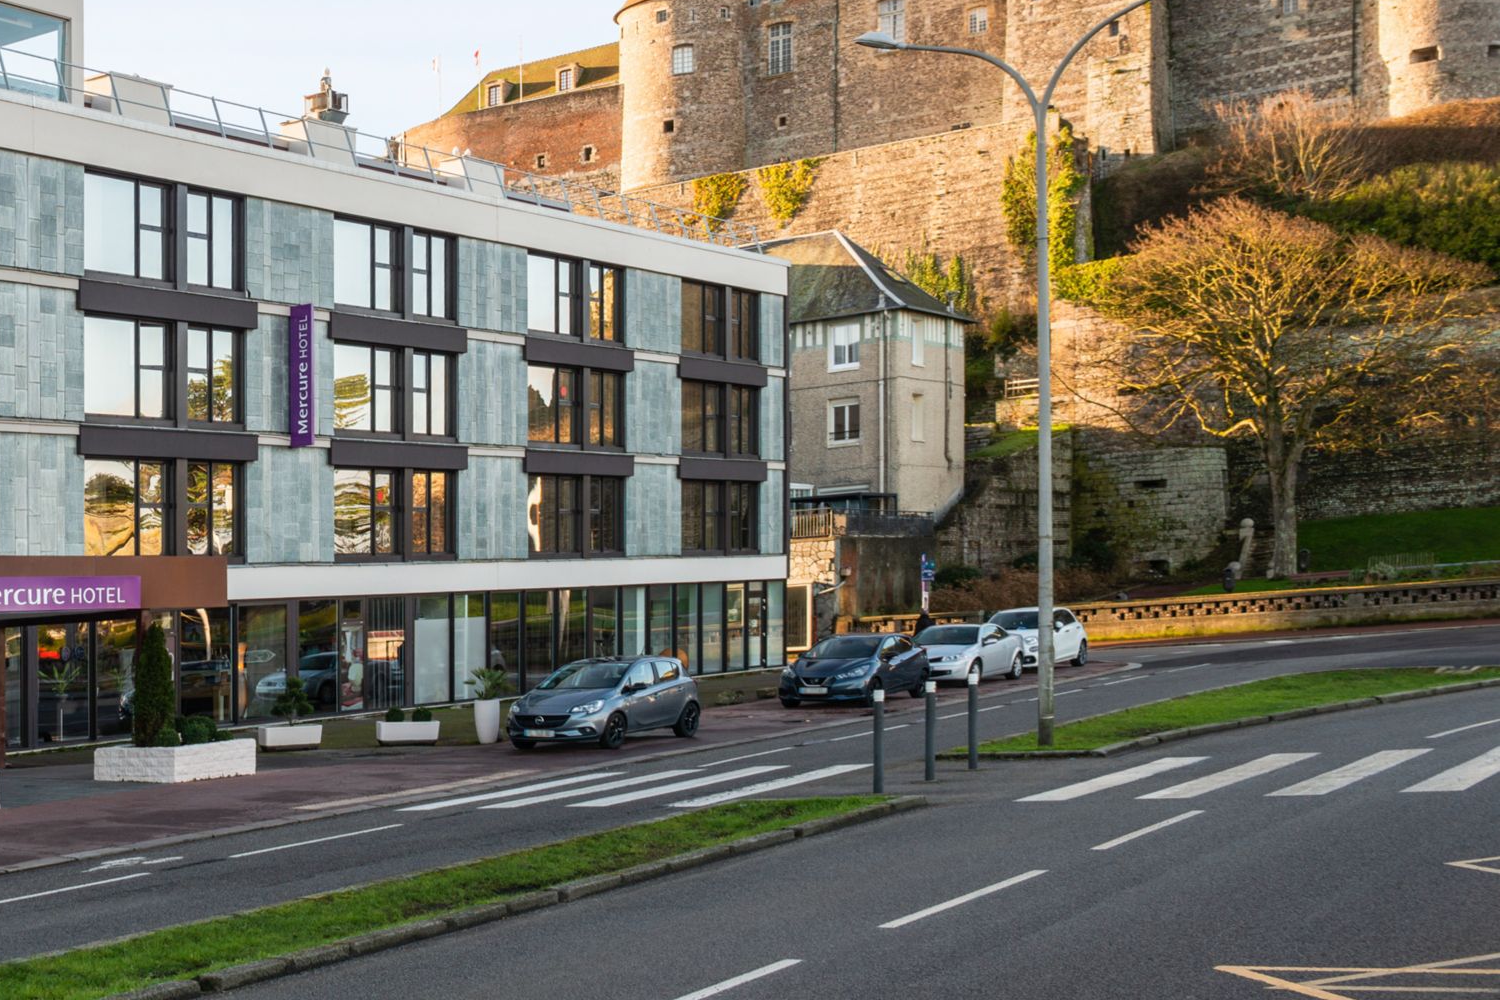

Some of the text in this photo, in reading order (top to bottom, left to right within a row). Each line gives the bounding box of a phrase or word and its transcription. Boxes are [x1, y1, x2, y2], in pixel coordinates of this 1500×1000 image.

[298, 315, 308, 434] Mercure HOTEL
[71, 586, 126, 605] HOTEL
